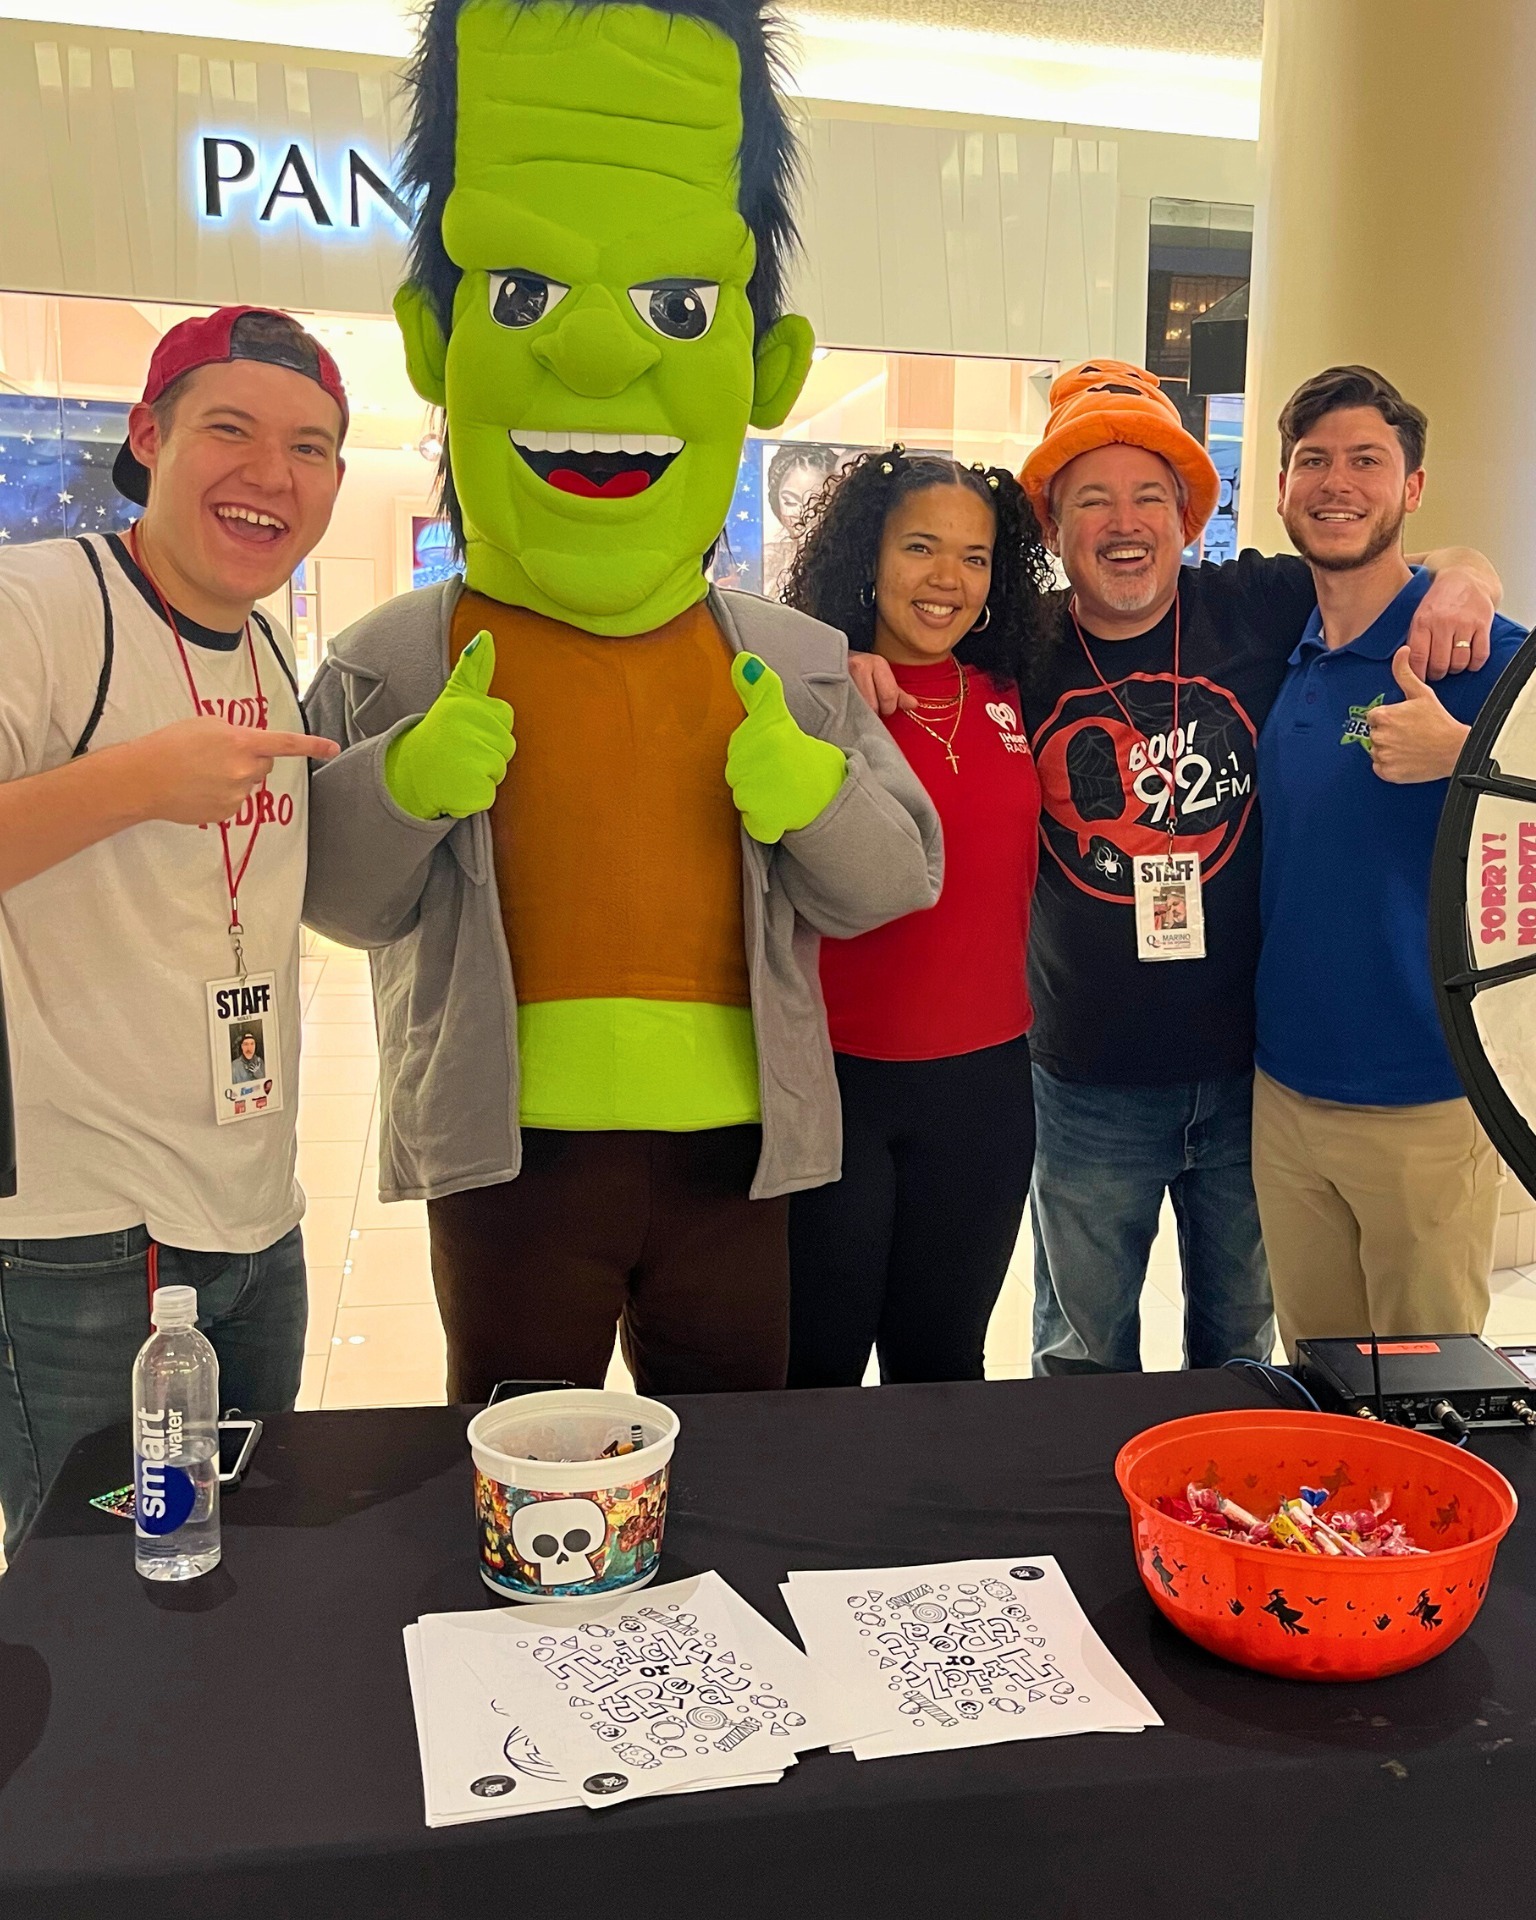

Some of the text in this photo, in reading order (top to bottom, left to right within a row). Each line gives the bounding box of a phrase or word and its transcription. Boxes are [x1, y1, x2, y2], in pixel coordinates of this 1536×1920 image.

[203, 137, 415, 231] PAN
[1128, 720, 1198, 772] BOO!
[199, 790, 293, 830] DRO
[1215, 774, 1250, 801] FM
[1141, 860, 1194, 883] STAFF
[1481, 833, 1507, 944] SORRY!
[1517, 907, 1536, 945] NO
[216, 984, 270, 1019] STAFF
[166, 1408, 183, 1459] water
[137, 1407, 166, 1519] smart
[544, 1630, 712, 1693] Trick
[640, 1663, 671, 1678] or
[900, 1648, 1065, 1701] Trick
[944, 1655, 976, 1666] or
